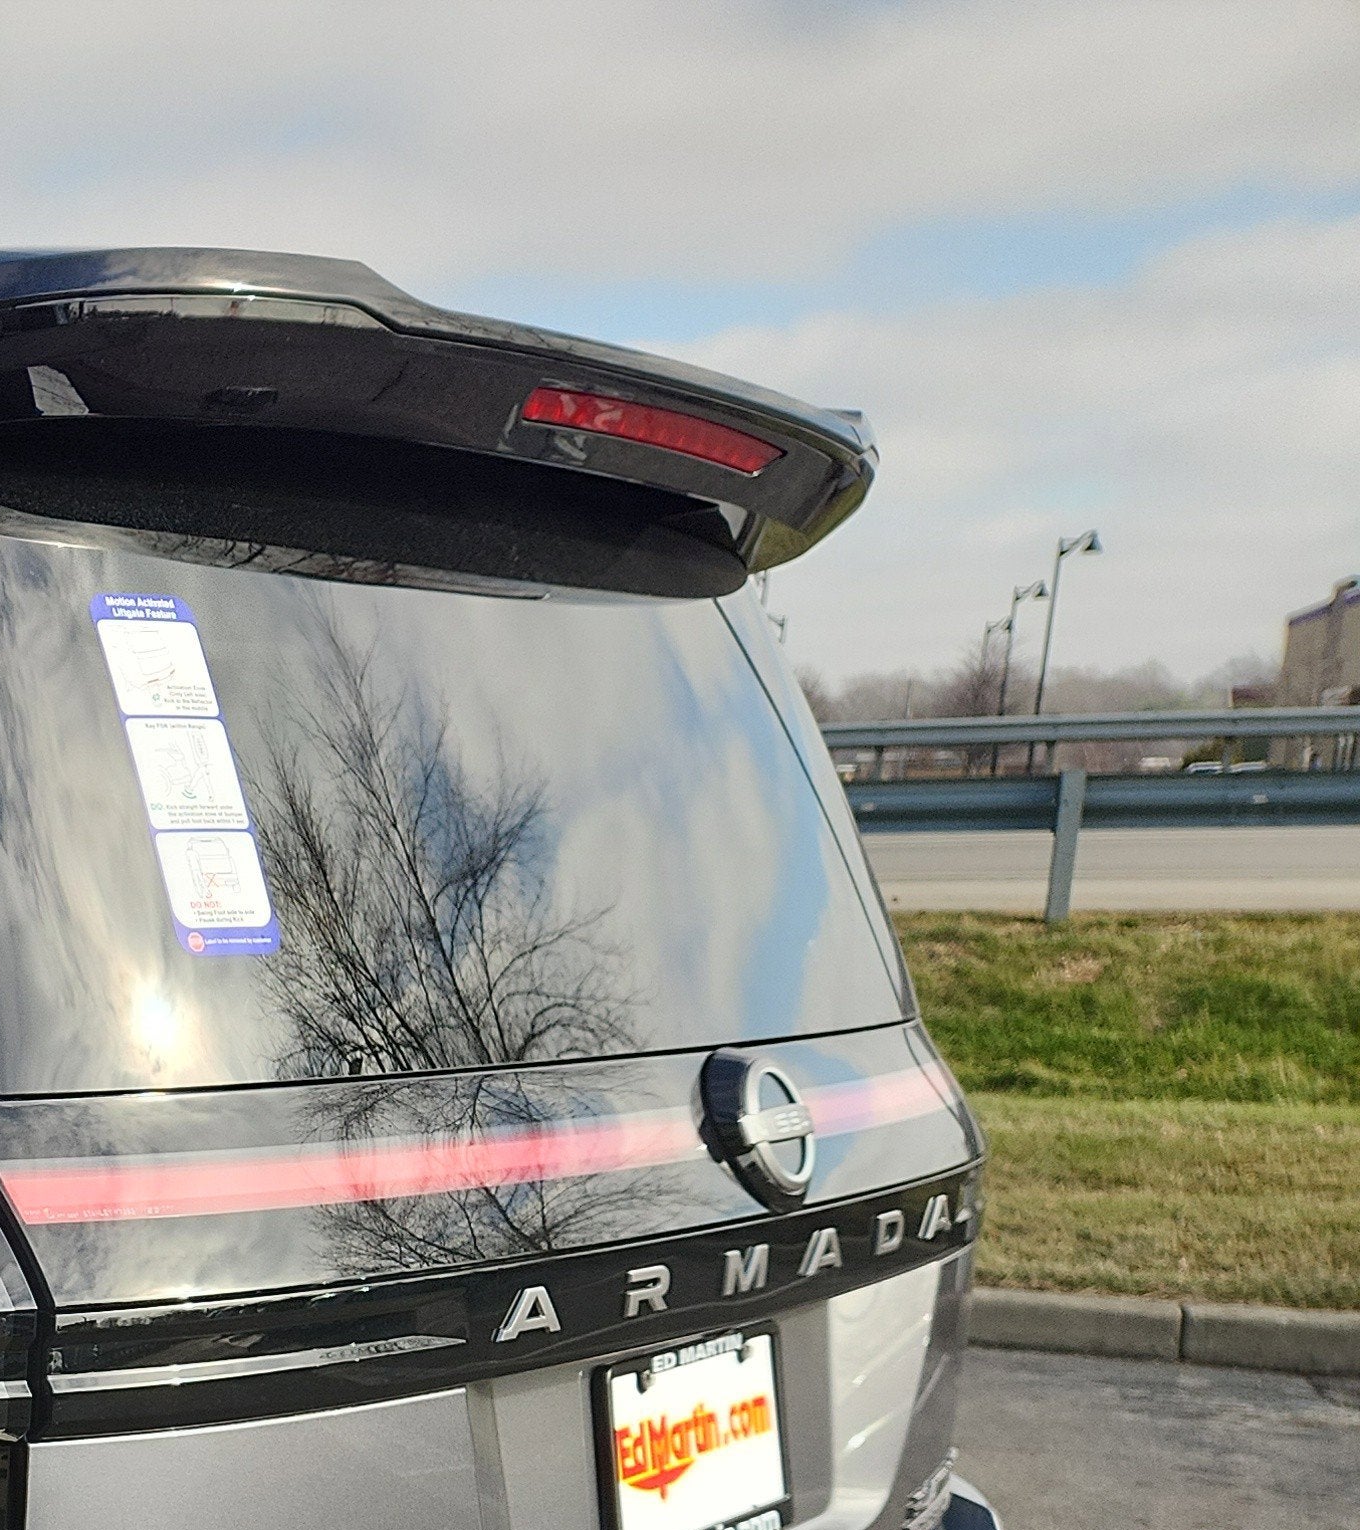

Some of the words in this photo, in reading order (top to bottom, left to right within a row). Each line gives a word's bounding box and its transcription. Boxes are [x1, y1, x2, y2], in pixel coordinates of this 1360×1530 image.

[105, 596, 136, 606] Motion
[137, 597, 175, 609] Activated
[112, 607, 144, 619] Liftgate
[145, 608, 177, 619] Feature
[492, 1194, 953, 1343] ARMADA
[651, 1353, 677, 1374] ED
[680, 1332, 744, 1366] MARTIN
[614, 1395, 771, 1481] EdMartin.com
